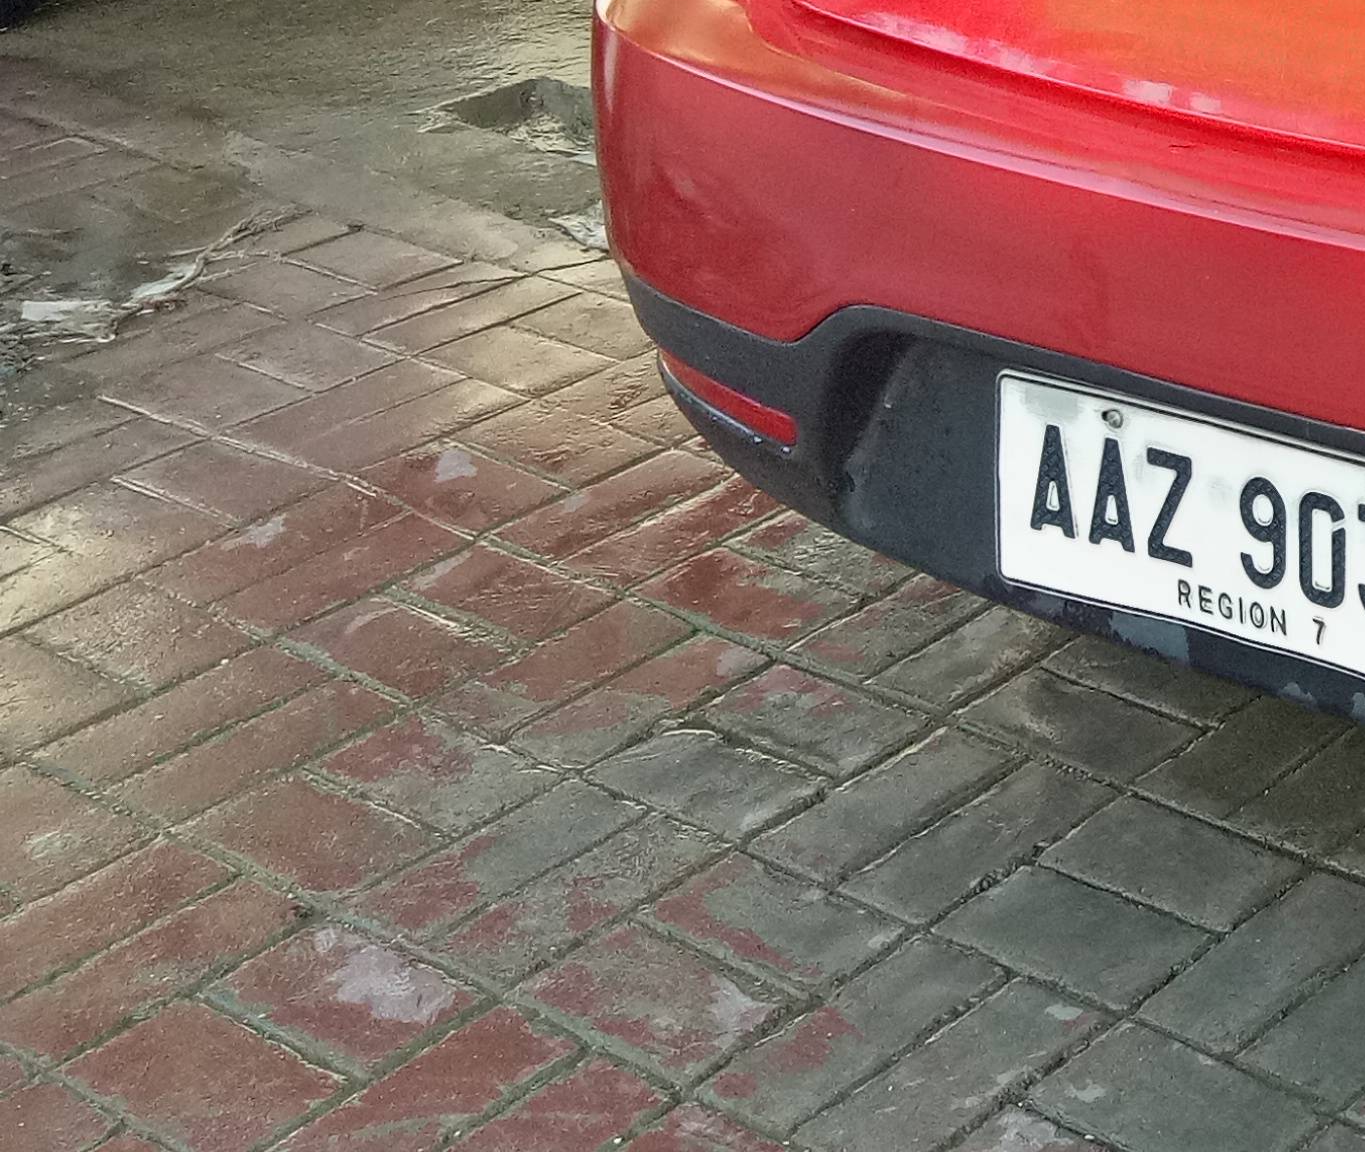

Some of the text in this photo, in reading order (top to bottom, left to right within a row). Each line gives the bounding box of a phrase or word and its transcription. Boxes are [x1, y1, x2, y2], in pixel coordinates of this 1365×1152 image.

[1030, 424, 1194, 568] AAZ
[1177, 579, 1326, 646] REGION 7
